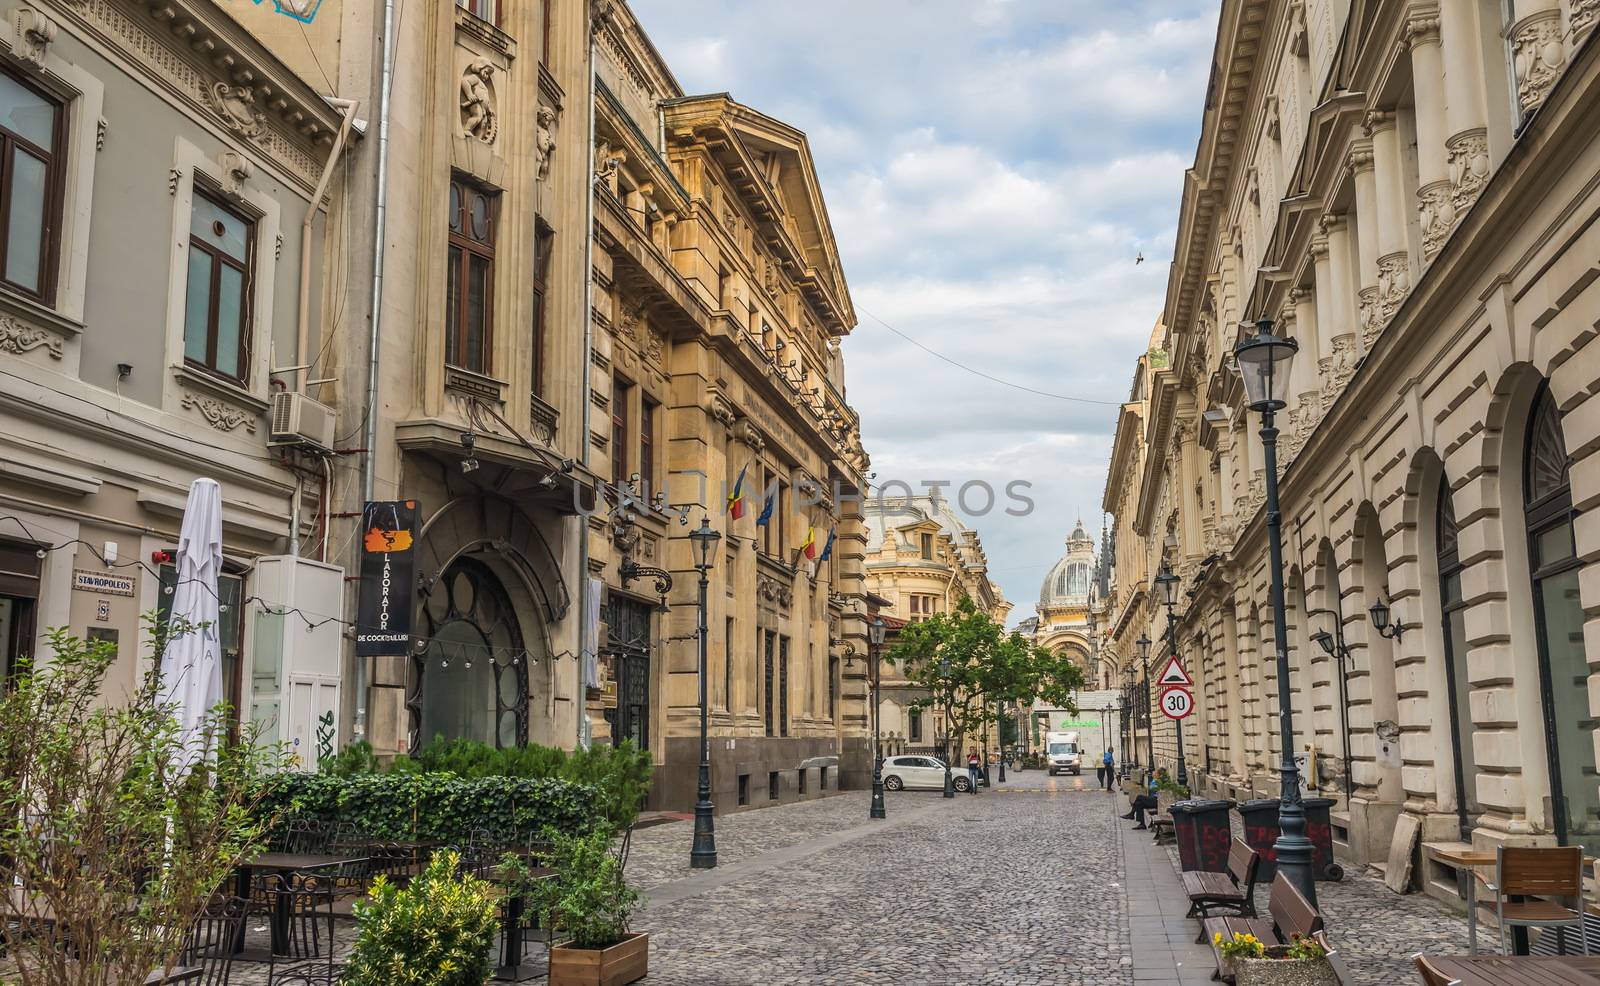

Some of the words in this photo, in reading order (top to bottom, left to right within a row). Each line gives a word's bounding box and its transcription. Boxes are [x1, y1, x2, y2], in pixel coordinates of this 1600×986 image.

[78, 575, 131, 590] STAVROPOLEOS
[380, 553, 391, 631] LABORATOR
[357, 634, 366, 642] DE
[366, 634, 409, 642] COCKILURI
[1167, 695, 1186, 711] 30
